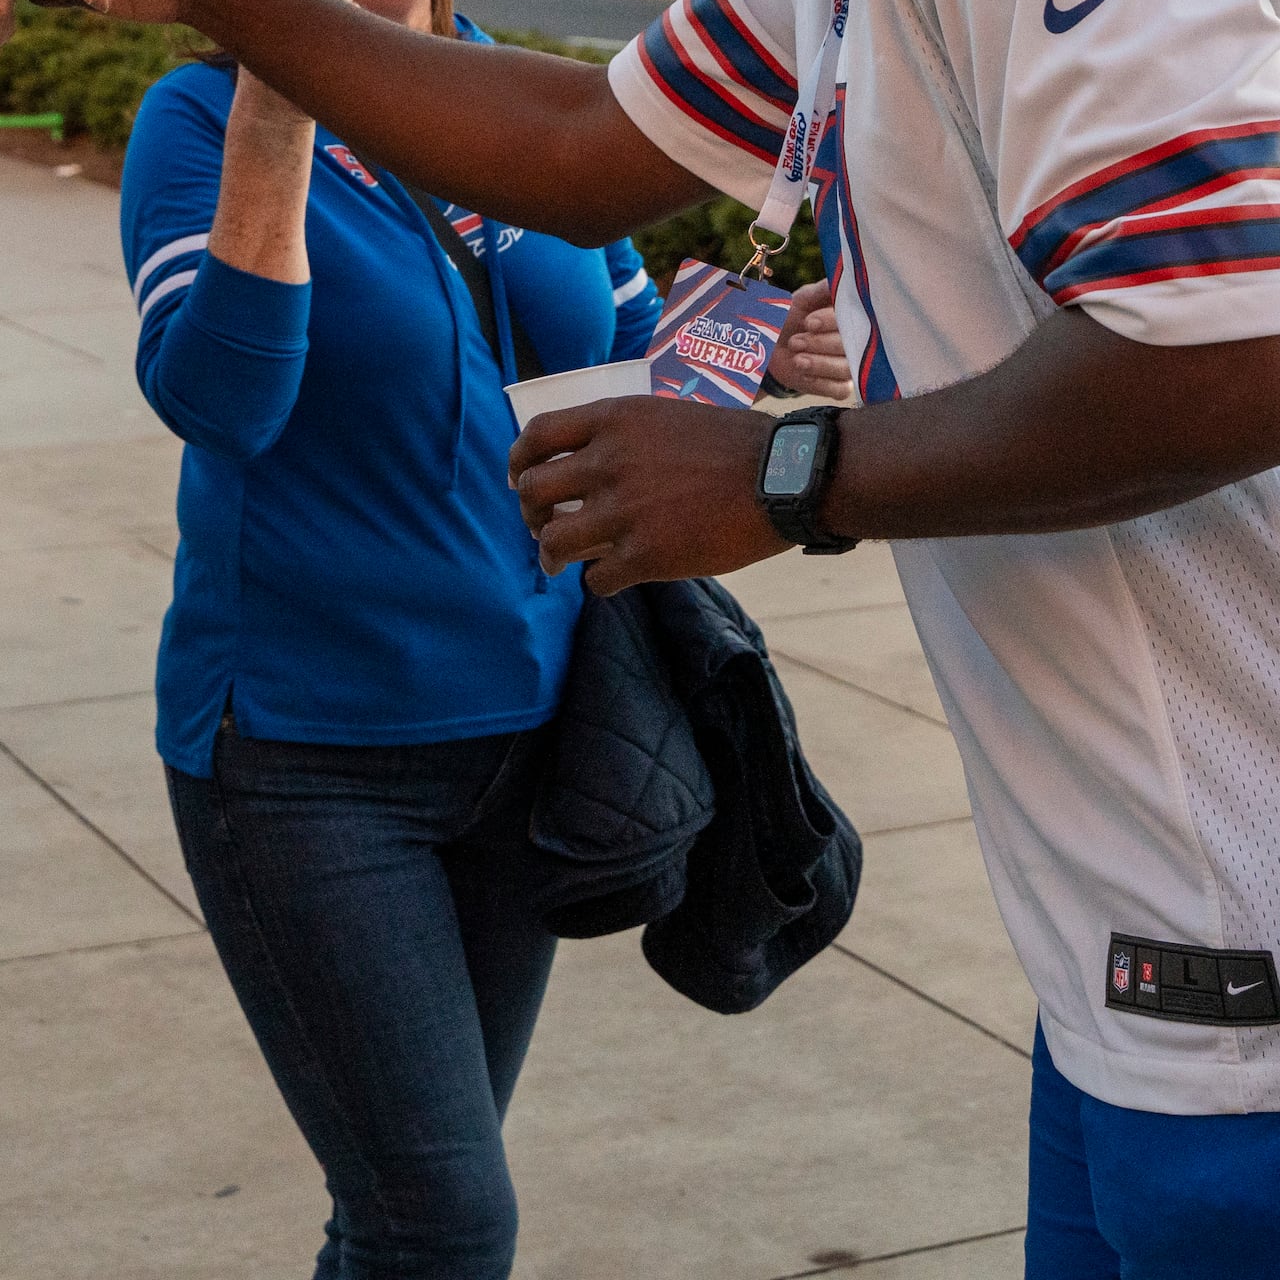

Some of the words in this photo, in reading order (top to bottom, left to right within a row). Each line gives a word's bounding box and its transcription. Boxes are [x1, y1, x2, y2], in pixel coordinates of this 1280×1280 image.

[783, 140, 795, 170] FANS
[785, 112, 806, 182] BUFFALO
[675, 321, 766, 374] BUFFALO
[692, 316, 733, 344] FANS
[730, 327, 760, 350] OF
[1183, 959, 1199, 986] L
